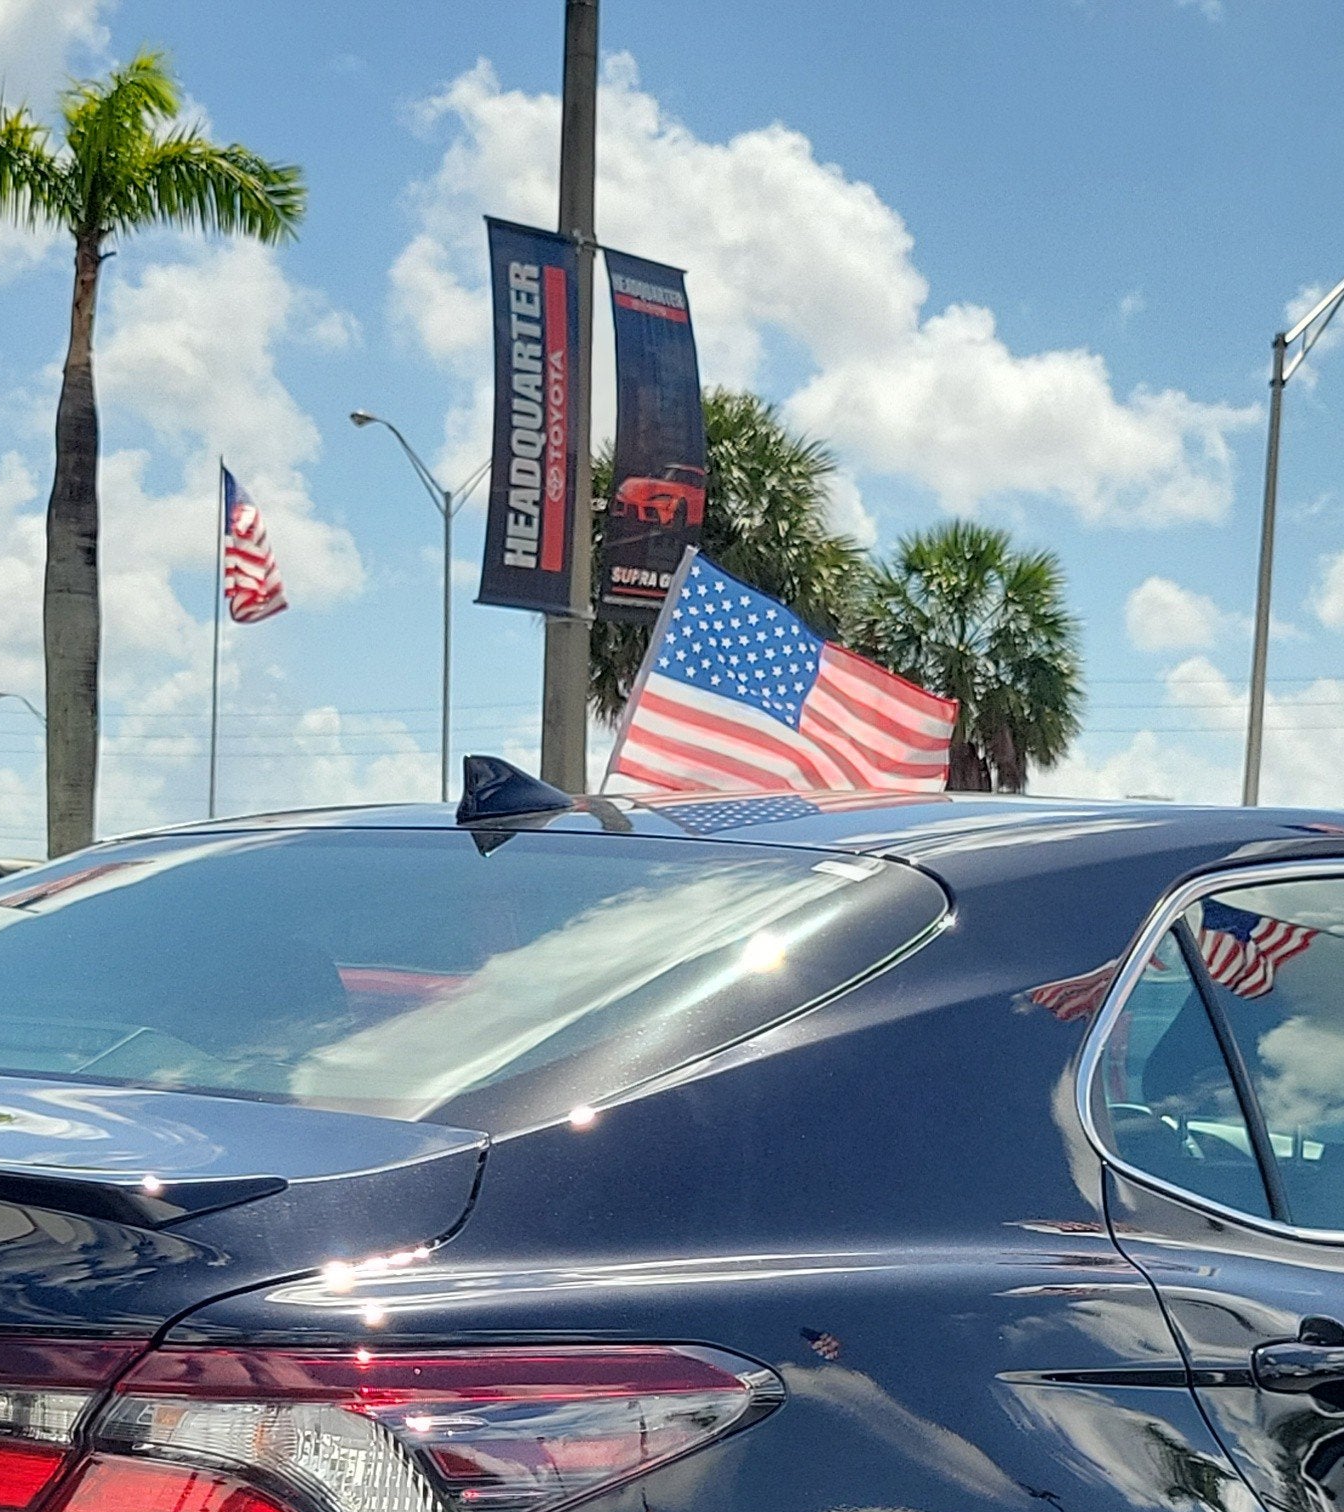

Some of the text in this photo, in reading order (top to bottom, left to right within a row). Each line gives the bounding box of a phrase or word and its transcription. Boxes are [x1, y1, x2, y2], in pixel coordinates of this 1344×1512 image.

[503, 261, 545, 570] HEADQUARTER
[548, 351, 565, 465] TOYOTA
[611, 566, 657, 588] SUPRA
